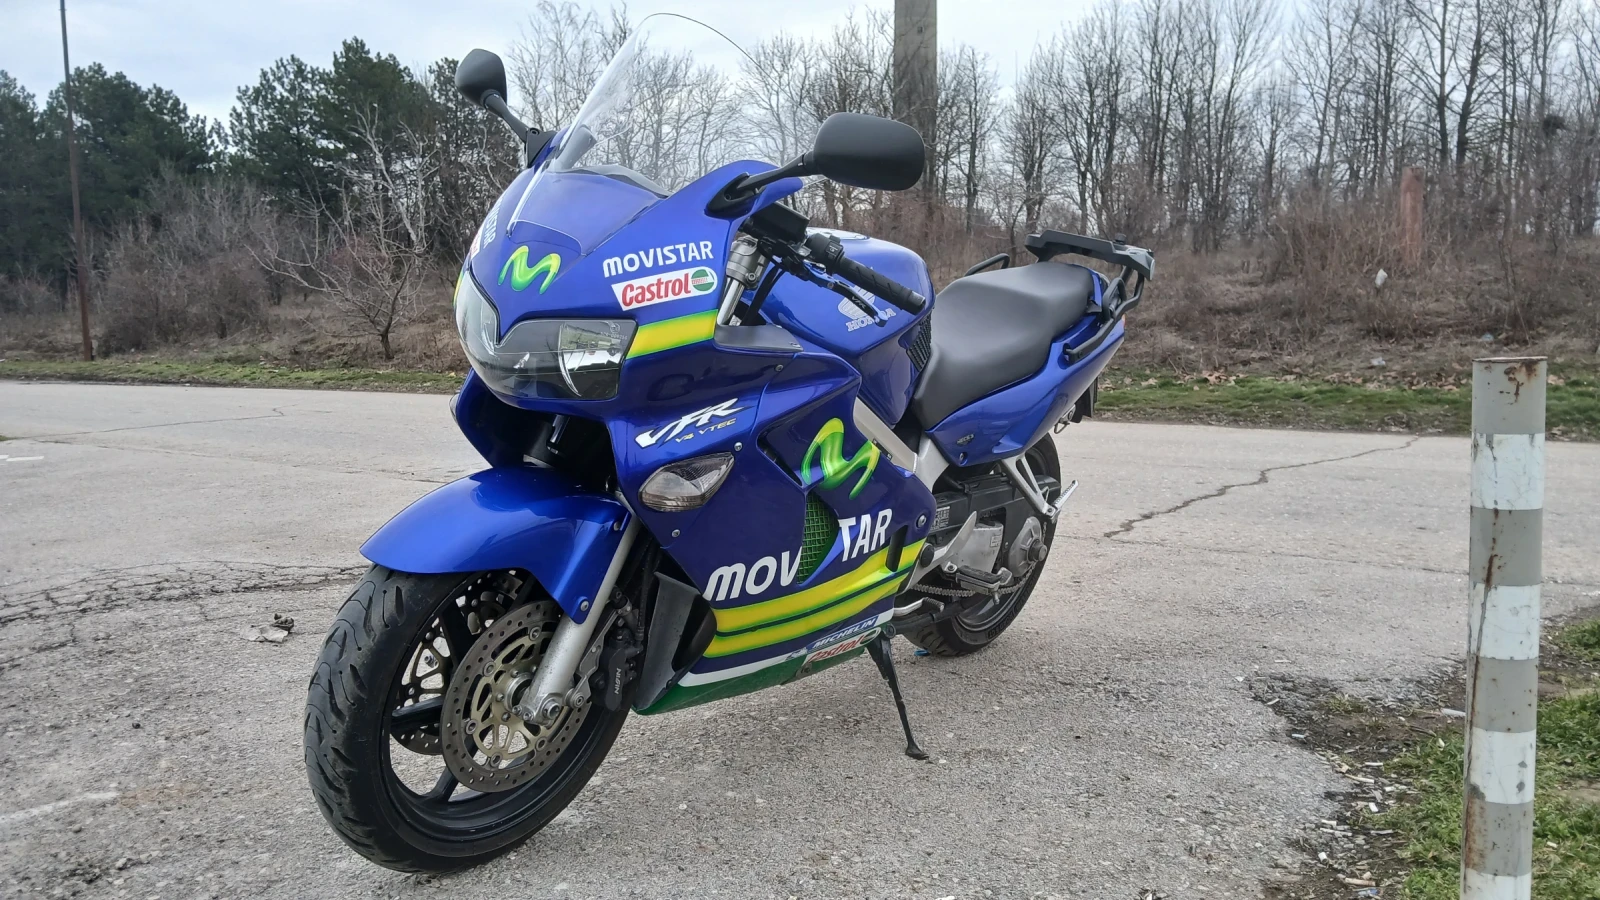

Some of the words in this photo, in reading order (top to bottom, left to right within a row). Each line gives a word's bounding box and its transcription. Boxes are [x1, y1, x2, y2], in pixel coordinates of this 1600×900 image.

[603, 240, 714, 278] MOVISTAR
[622, 272, 692, 307] Castrol
[635, 398, 745, 448] VFR
[698, 418, 737, 434] VTEC
[808, 635, 865, 662] Castrol
[812, 618, 876, 648] MICHELIN
